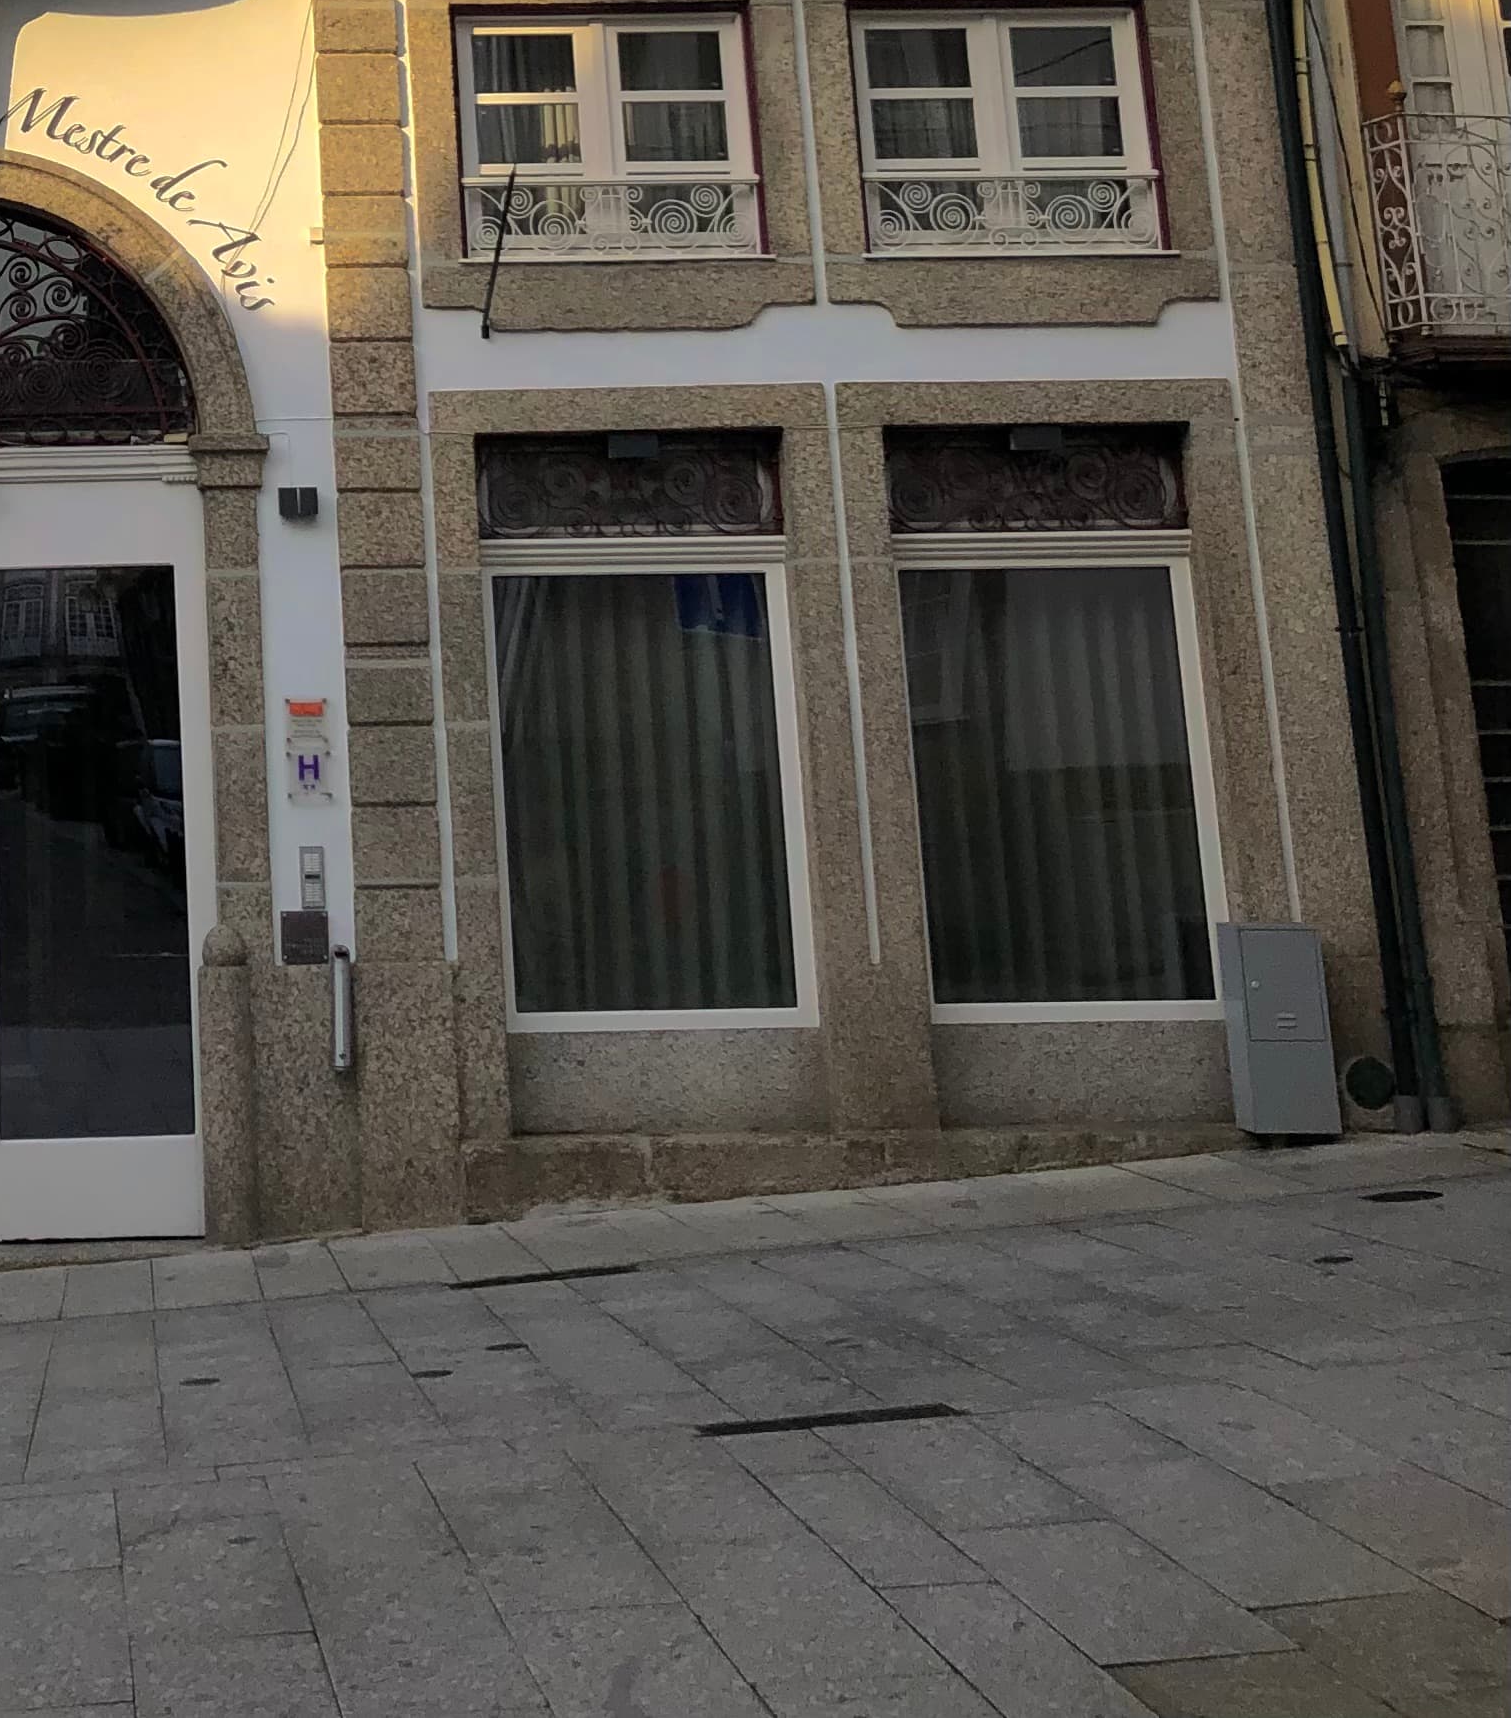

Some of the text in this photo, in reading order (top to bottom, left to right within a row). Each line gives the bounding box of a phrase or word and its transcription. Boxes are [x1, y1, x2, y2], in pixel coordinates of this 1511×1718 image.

[150, 159, 228, 212] de
[186, 218, 276, 312] Avis
[298, 755, 320, 781] H
